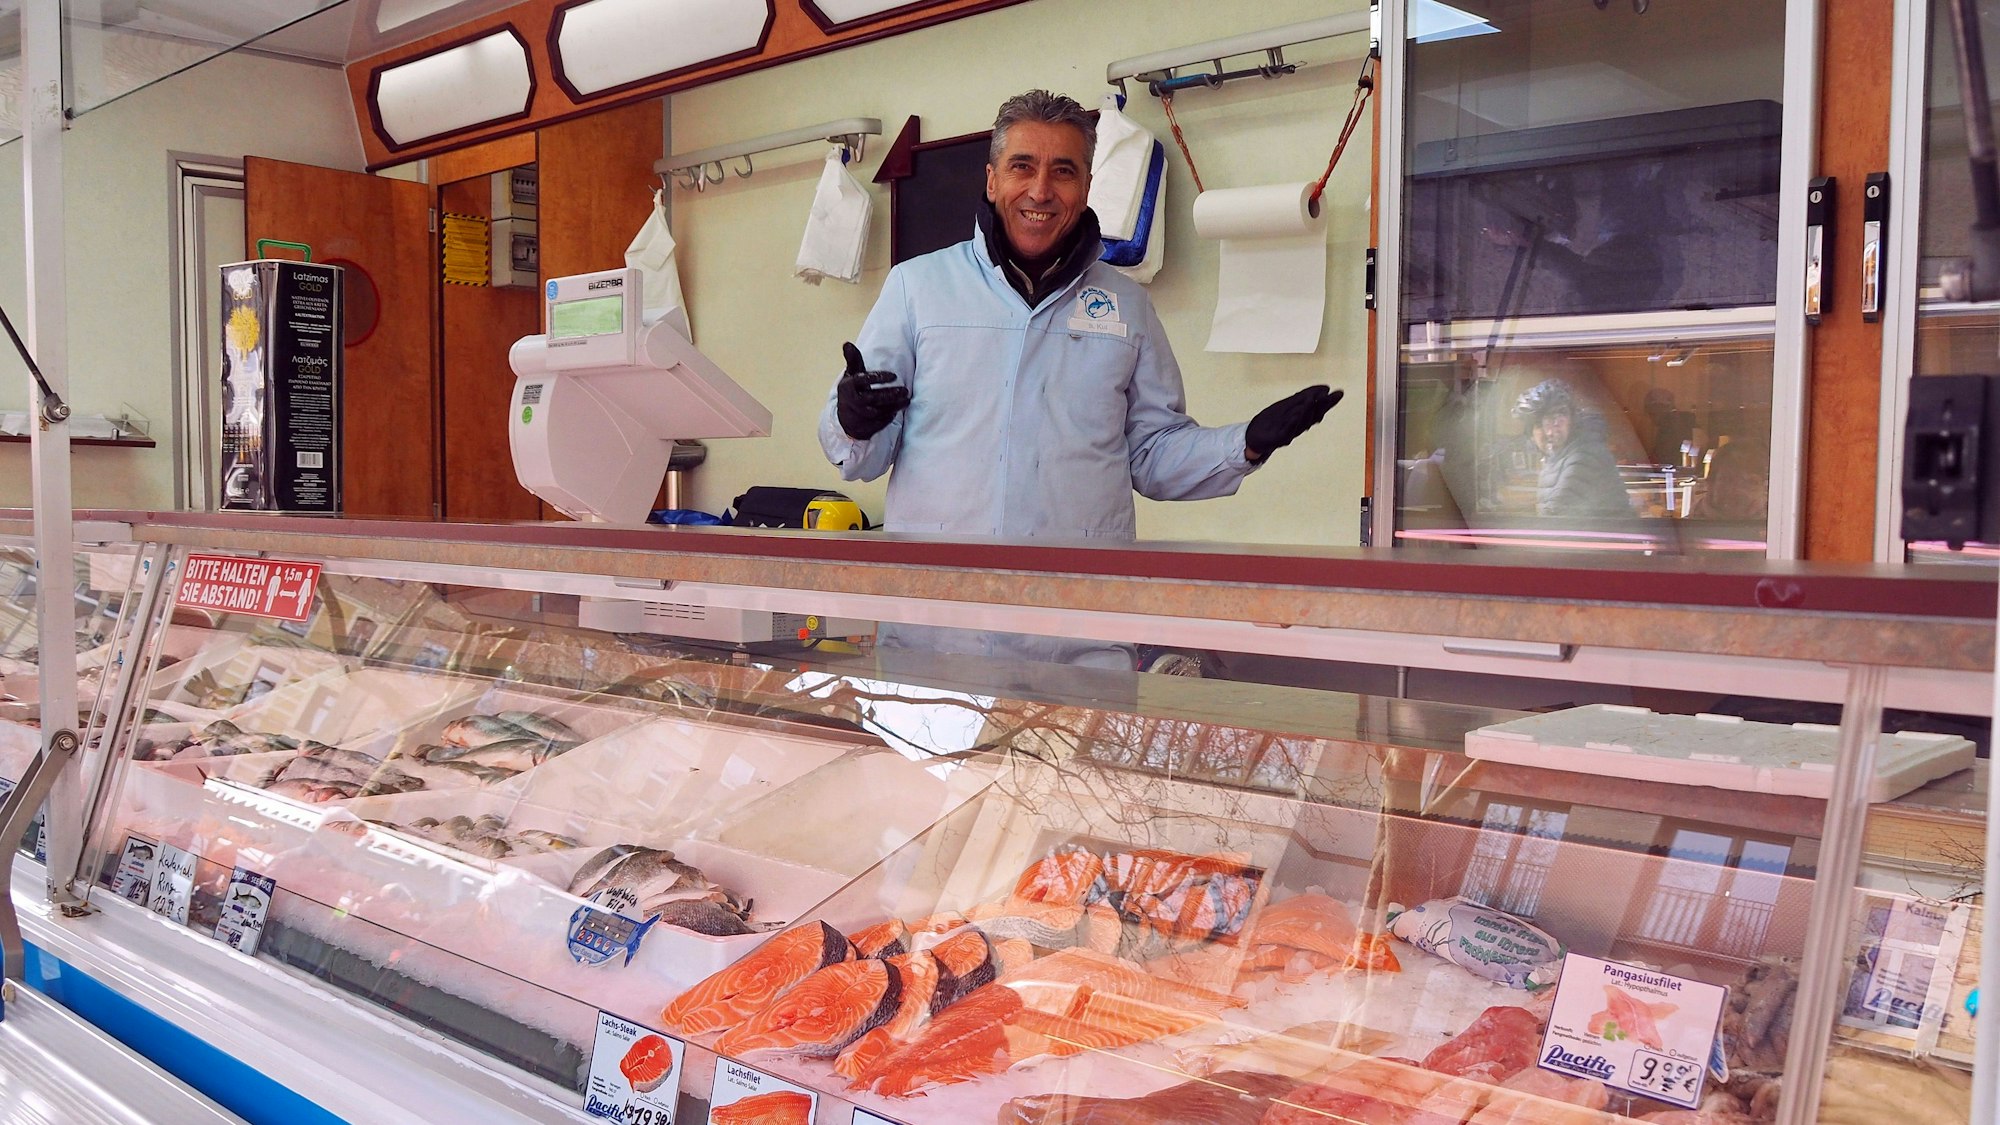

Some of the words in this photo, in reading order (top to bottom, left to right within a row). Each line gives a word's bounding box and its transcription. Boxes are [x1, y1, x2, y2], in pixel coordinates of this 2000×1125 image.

[293, 272, 329, 284] Latzimas
[299, 282, 322, 292] GOLD
[588, 278, 623, 291] BIZERBA
[291, 355, 328, 367] Λατζιμάς
[298, 364, 322, 374] GOLD
[185, 559, 222, 580] BITTE
[219, 562, 269, 586] HALTEN
[180, 582, 202, 603] SIE
[200, 584, 262, 610] ABSTAND!
[606, 898, 625, 913] File
[1474, 916, 1516, 934] Immer
[1474, 929, 1498, 944] aus
[1497, 936, 1540, 956] Ihrem
[1603, 964, 1682, 991] Pangasiusfilet
[601, 1016, 637, 1037] Lachs-Steak
[1543, 1044, 1616, 1074] Pacific
[727, 1064, 761, 1085] Lachsfilet
[586, 1093, 625, 1121] Pacific
